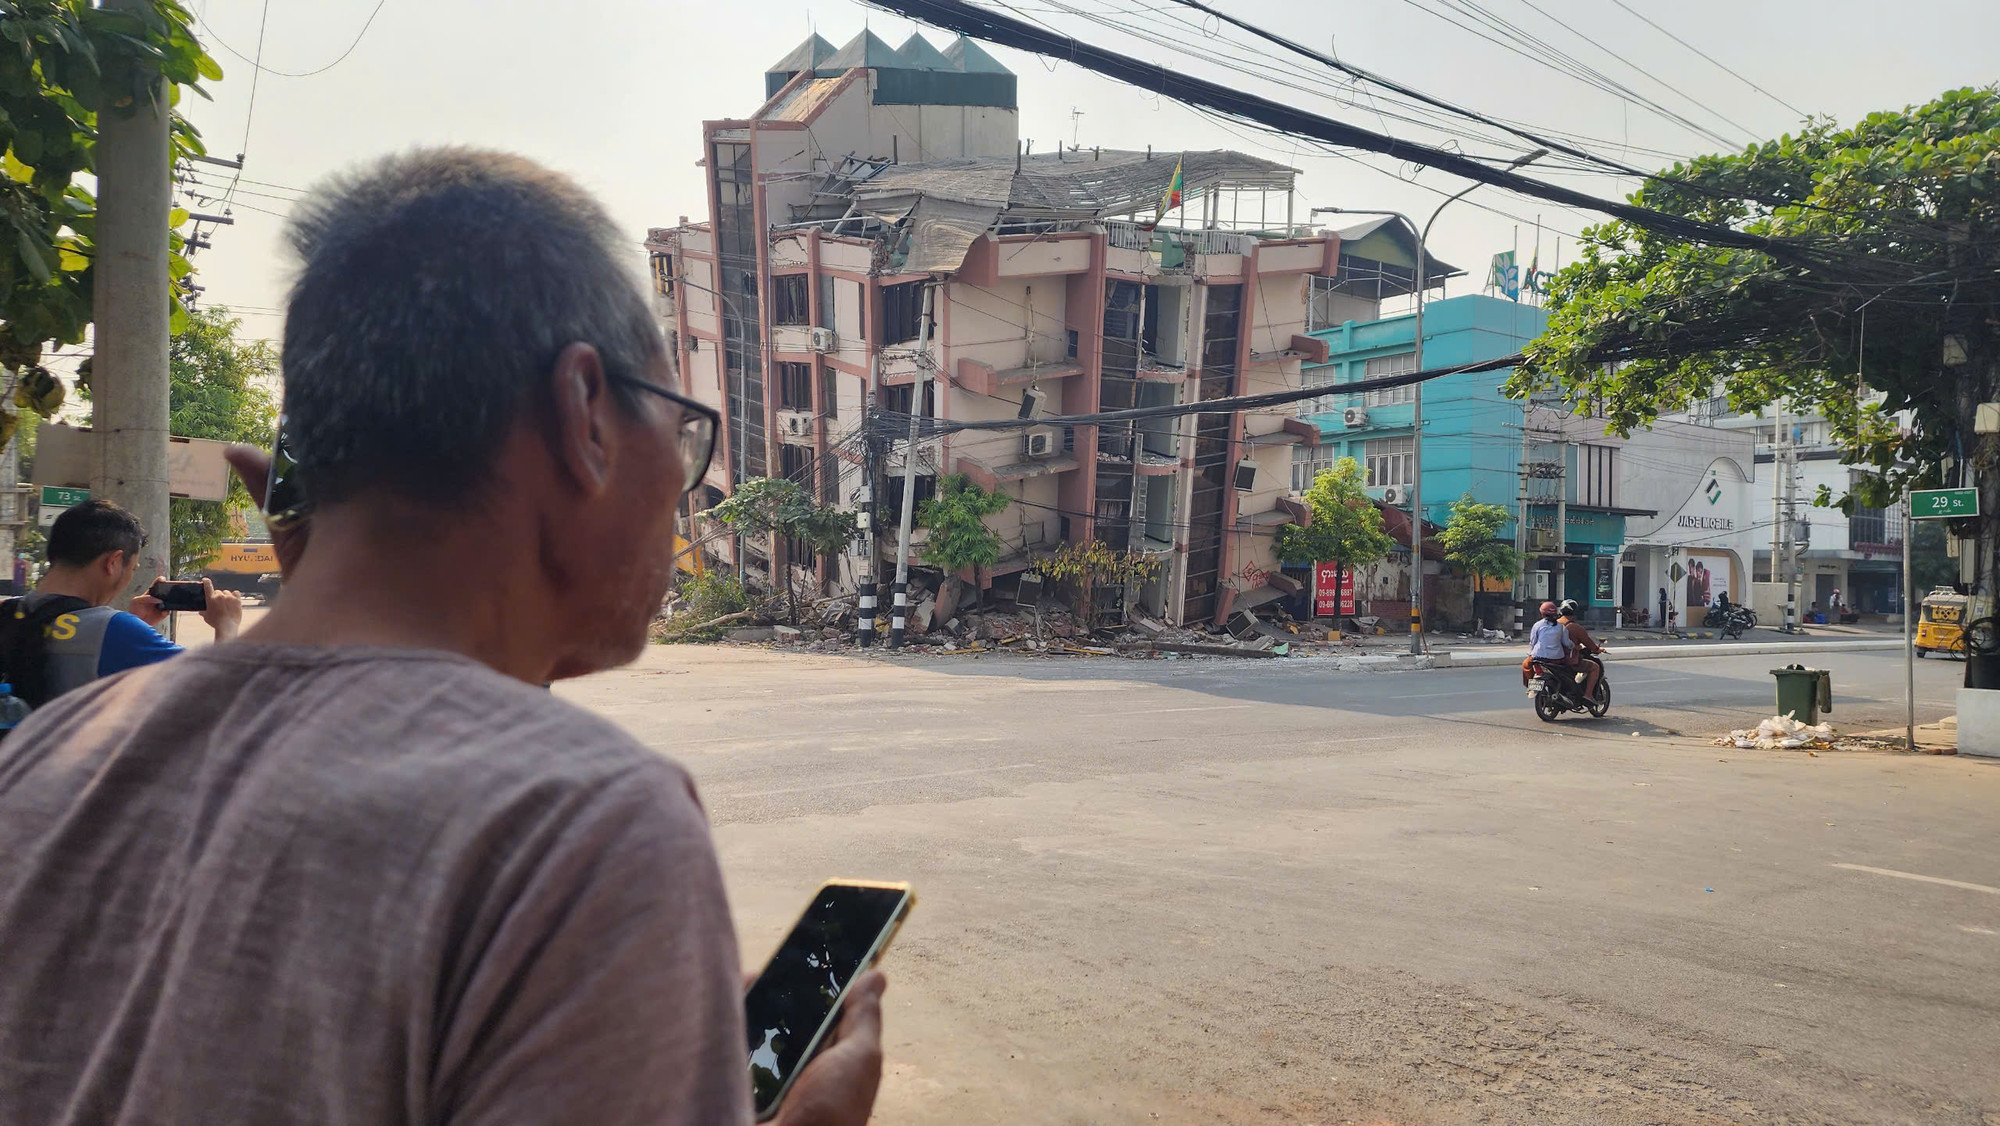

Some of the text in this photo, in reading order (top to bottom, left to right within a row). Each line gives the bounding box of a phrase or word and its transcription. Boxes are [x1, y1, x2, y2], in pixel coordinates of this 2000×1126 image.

[58, 491, 70, 500] 73
[1932, 496, 1965, 508] 29 St.
[1678, 515, 1734, 530] JADE MOBILE
